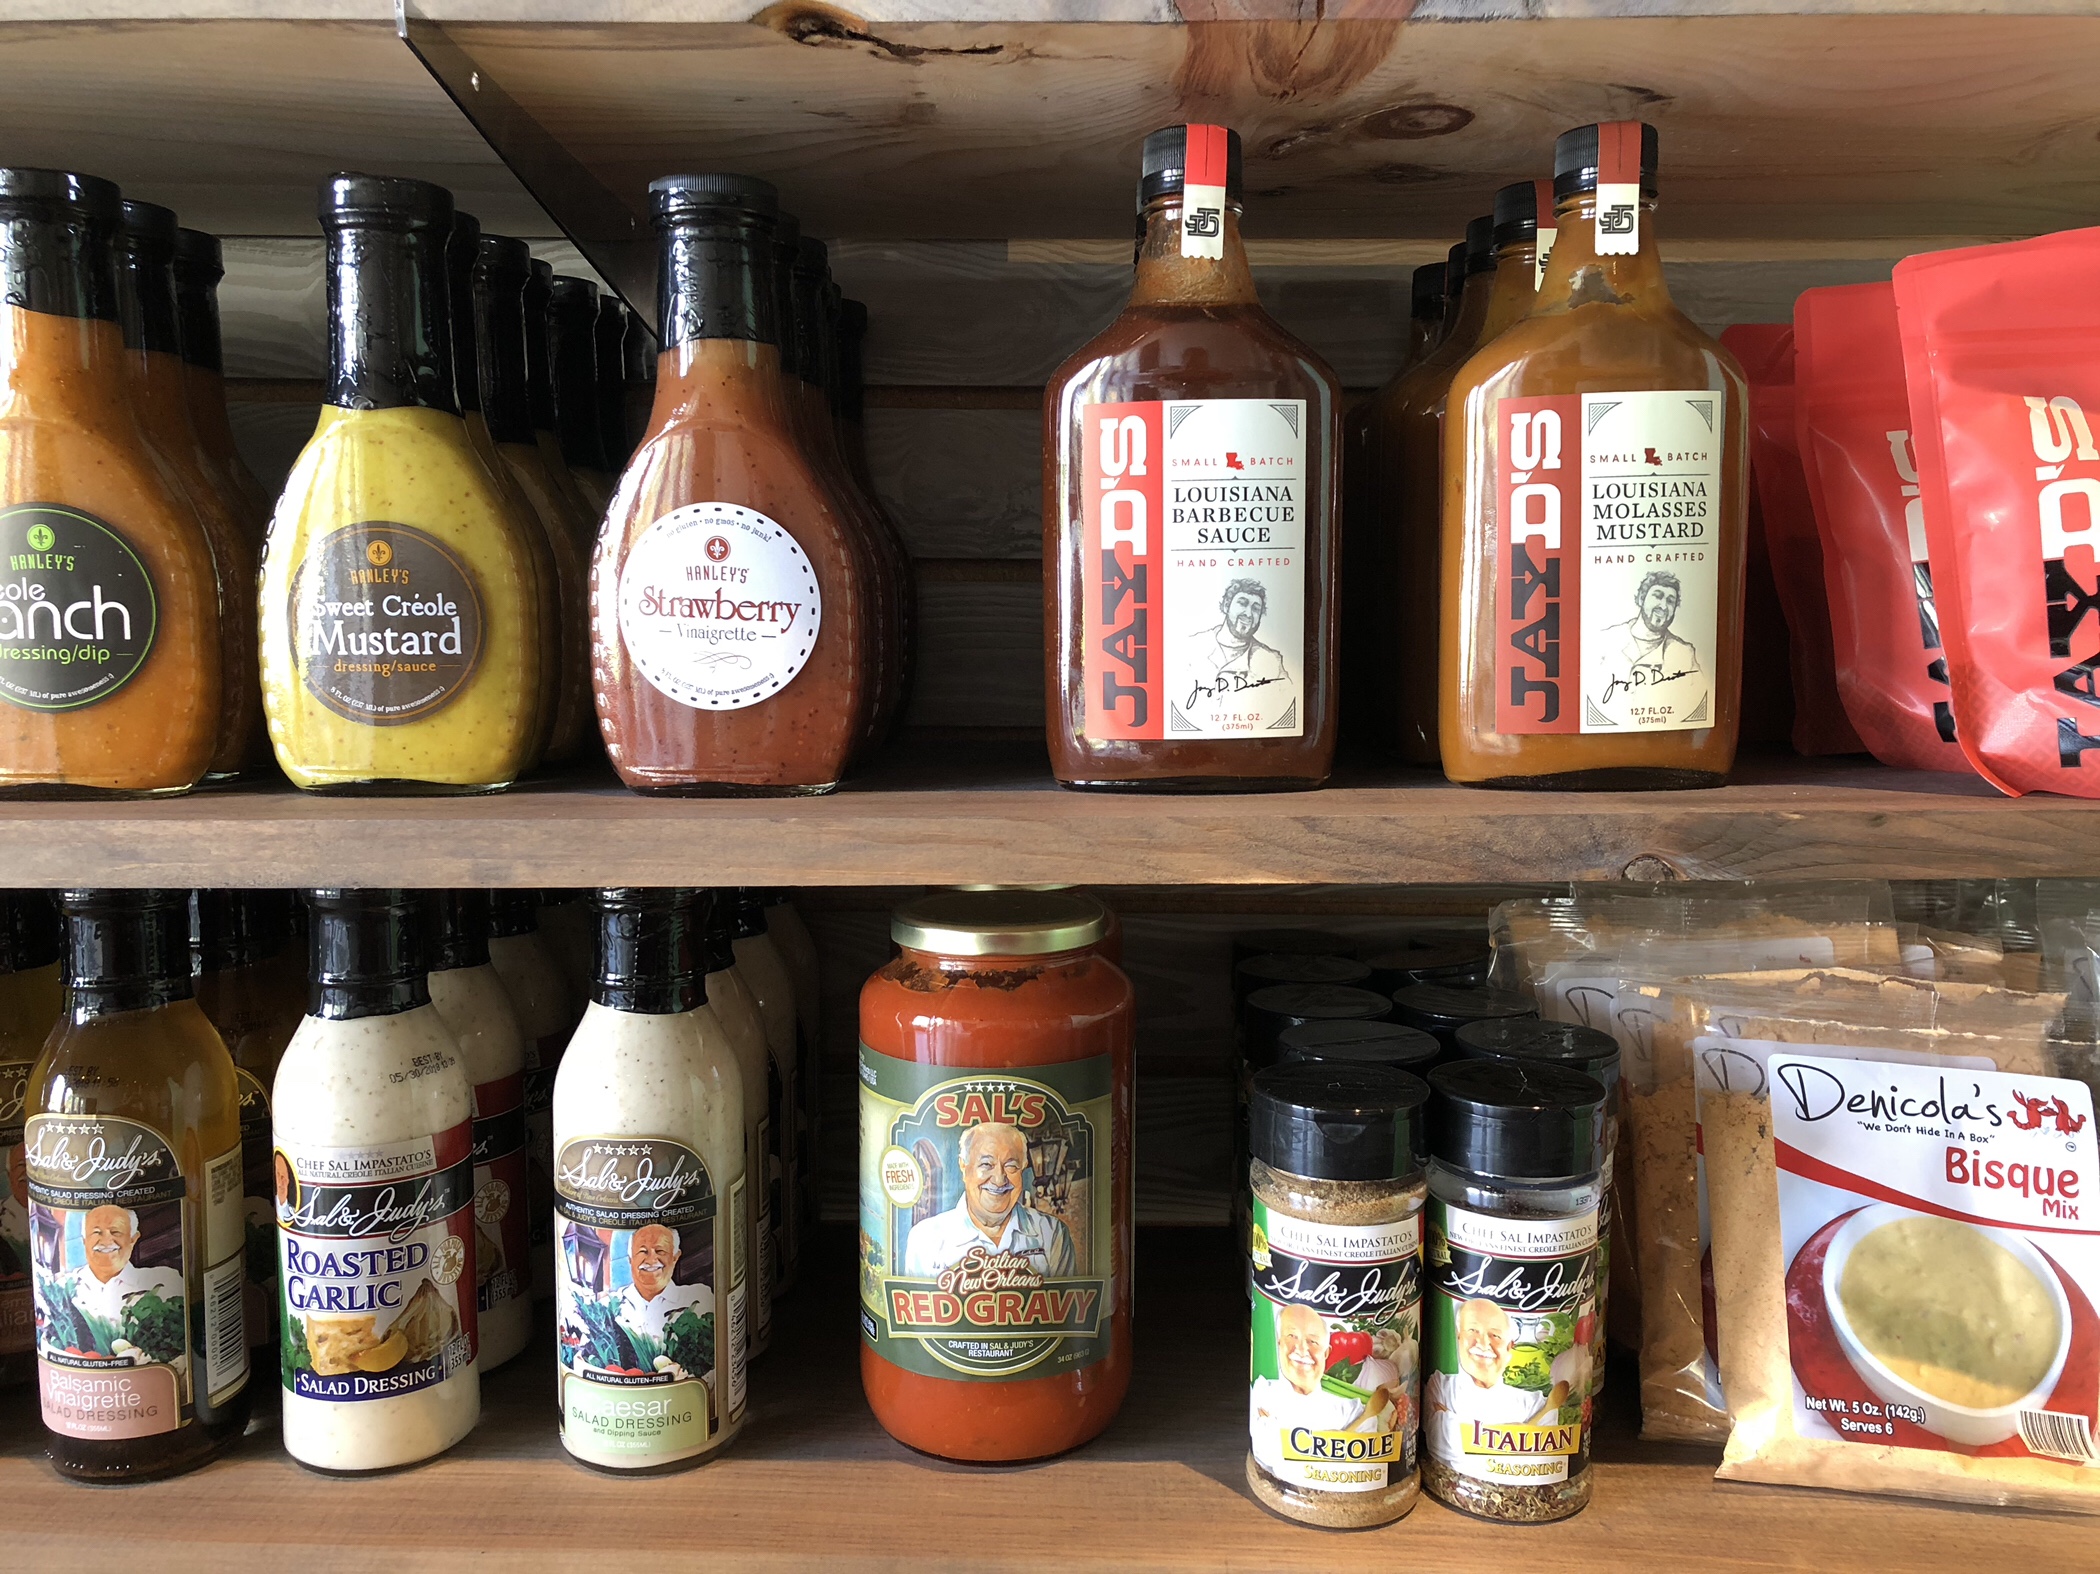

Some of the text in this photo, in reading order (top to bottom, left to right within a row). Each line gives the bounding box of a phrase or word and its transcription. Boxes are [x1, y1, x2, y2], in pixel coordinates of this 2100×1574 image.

[1172, 457, 1294, 467] SMALL BATCH
[1590, 452, 1708, 463] SMALL BATCH
[1174, 486, 1293, 503] LOUISIANA
[1592, 482, 1707, 499] LOUISIANA
[1172, 506, 1294, 523] BARBECUE
[1593, 501, 1706, 519] MOLASSES
[1197, 527, 1271, 544] SAUCE
[1596, 523, 1704, 540] MUSTARD
[10, 554, 76, 571] HANLEY'S
[1177, 557, 1290, 567] HAND CRAFTED
[1595, 553, 1705, 564] HAND CRAFTED
[350, 569, 410, 584] HANLEY'S
[686, 566, 749, 583] HANLEY'S
[312, 593, 457, 616] Sweet Créole
[639, 585, 802, 634] Strawberry
[311, 616, 462, 655] Mustard
[677, 623, 756, 645] Vinaigrette
[334, 659, 436, 677] dressing/sauce
[412, 1051, 443, 1067] BEST BY
[1777, 1063, 2003, 1127] Denicola's
[935, 1092, 1047, 1128] SAL'S
[1885, 1124, 1965, 1140] Don't Hide In A
[297, 1150, 431, 1171] CHEF SAL IMPASTATO'S
[343, 1170, 373, 1178] CREOLE
[375, 1167, 405, 1176] ITALIAN
[886, 1170, 914, 1183] FRESH
[1945, 1146, 2080, 1200] Bisque
[51, 1187, 155, 1199] SALAD DRESSING CREATED
[662, 1206, 694, 1217] CREATED
[2042, 1197, 2080, 1220] Mix
[1317, 1235, 1338, 1248] SAL
[1344, 1231, 1412, 1249] IMPASTATO'S
[1501, 1231, 1522, 1243] SAL
[1528, 1225, 1591, 1243] IMPASTATO'S
[287, 1238, 429, 1278] ROASTED
[961, 1247, 1028, 1272] Sicilian
[1345, 1250, 1374, 1258] CREOLE
[938, 1268, 1041, 1294] New Orleans
[289, 1276, 402, 1311] GARLIC
[891, 1290, 963, 1325] RED
[964, 1289, 1097, 1325] GRAVY
[948, 1341, 979, 1349] CRAFTED
[990, 1342, 1002, 1350] SAL
[1010, 1340, 1034, 1349] JUDY'S
[968, 1349, 1013, 1357] RESTAURANT
[82, 1359, 128, 1367] GLUTEN-FREE
[50, 1370, 131, 1392] Balsamic
[301, 1367, 436, 1395] SALAD DRESSING
[586, 1373, 668, 1384] ALL NATURAL GLUTEN-FREE
[47, 1382, 141, 1411] Vinaigrette
[77, 1406, 158, 1421] DRESSING
[600, 1398, 672, 1417] aesar
[1806, 1396, 1828, 1411] Net
[1829, 1398, 1849, 1414] Wt.
[1852, 1400, 1859, 1414] 5
[1862, 1402, 1882, 1417] Oz.
[572, 1407, 692, 1429] SALAD DRESSING
[1840, 1417, 1894, 1436] Serves 6
[1290, 1427, 1394, 1459] CREOLE
[1473, 1420, 1574, 1452] ITALIAN
[1304, 1464, 1381, 1483] SEASONING
[1486, 1458, 1563, 1477] SEASONING
